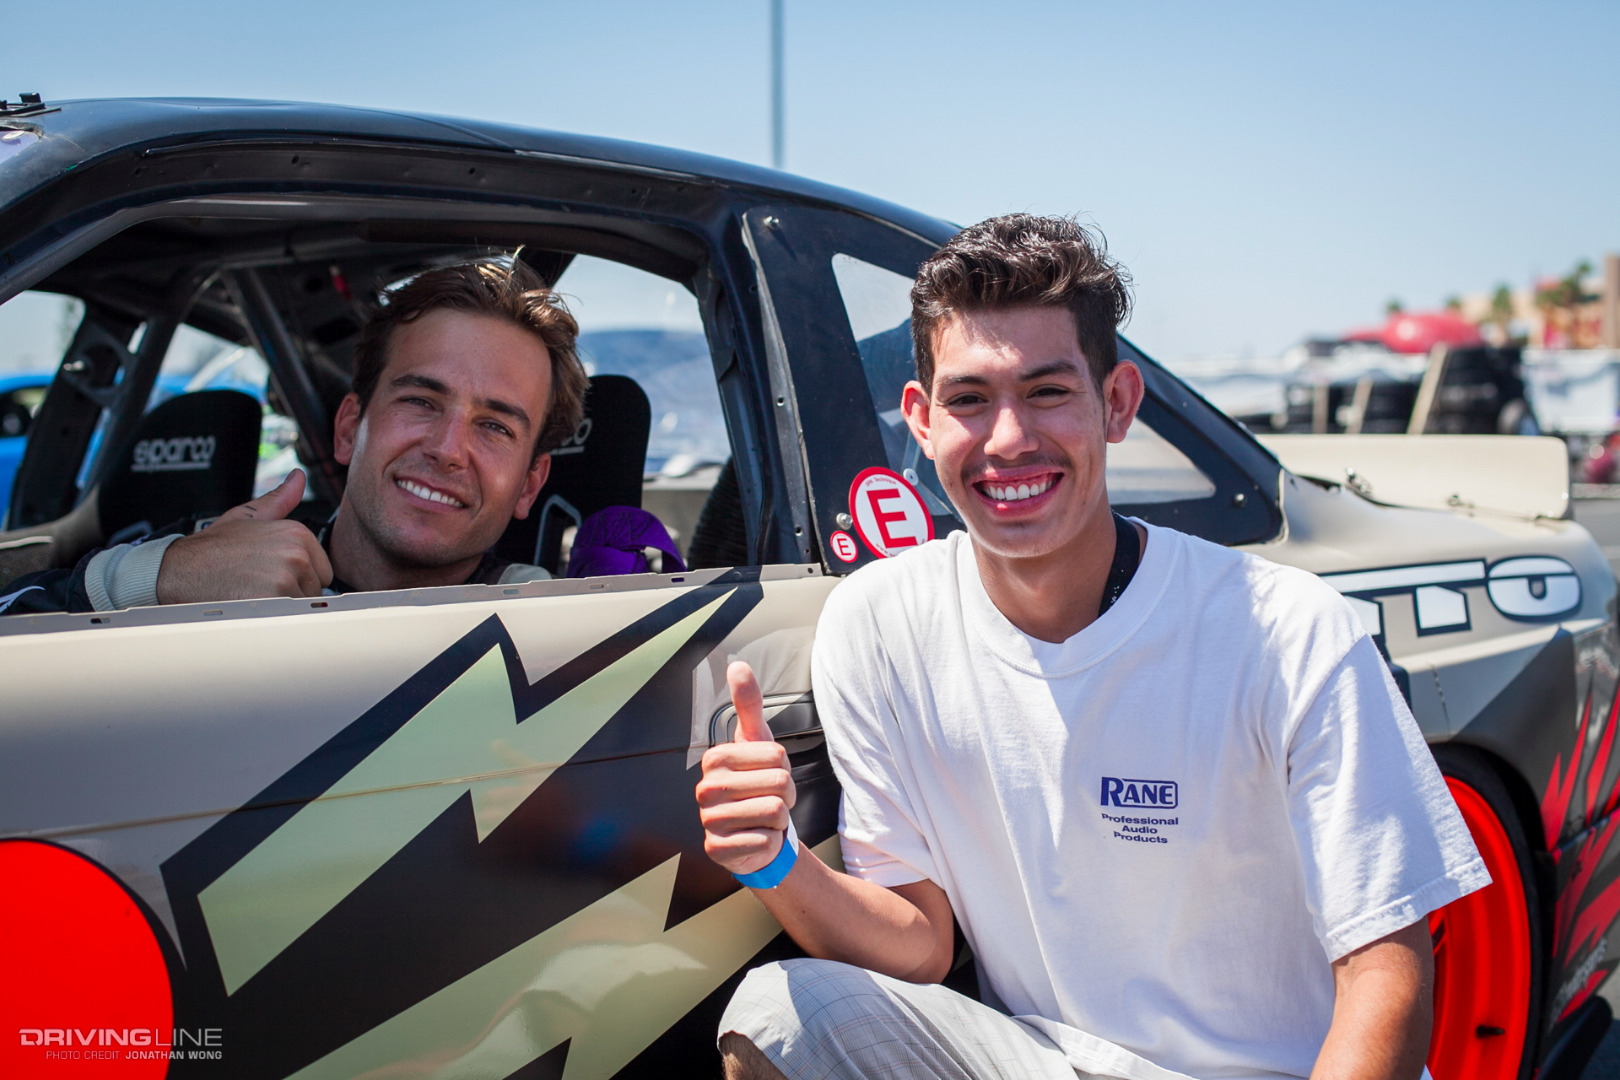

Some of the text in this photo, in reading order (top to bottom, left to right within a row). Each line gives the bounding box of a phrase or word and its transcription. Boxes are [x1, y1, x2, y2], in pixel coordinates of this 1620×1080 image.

[132, 435, 216, 466] sparco
[866, 488, 918, 548] E
[836, 538, 852, 556] E
[1100, 776, 1174, 807] RANE
[1101, 812, 1179, 825] Professional
[1113, 831, 1168, 844] Products
[1121, 825, 1158, 834] Audio
